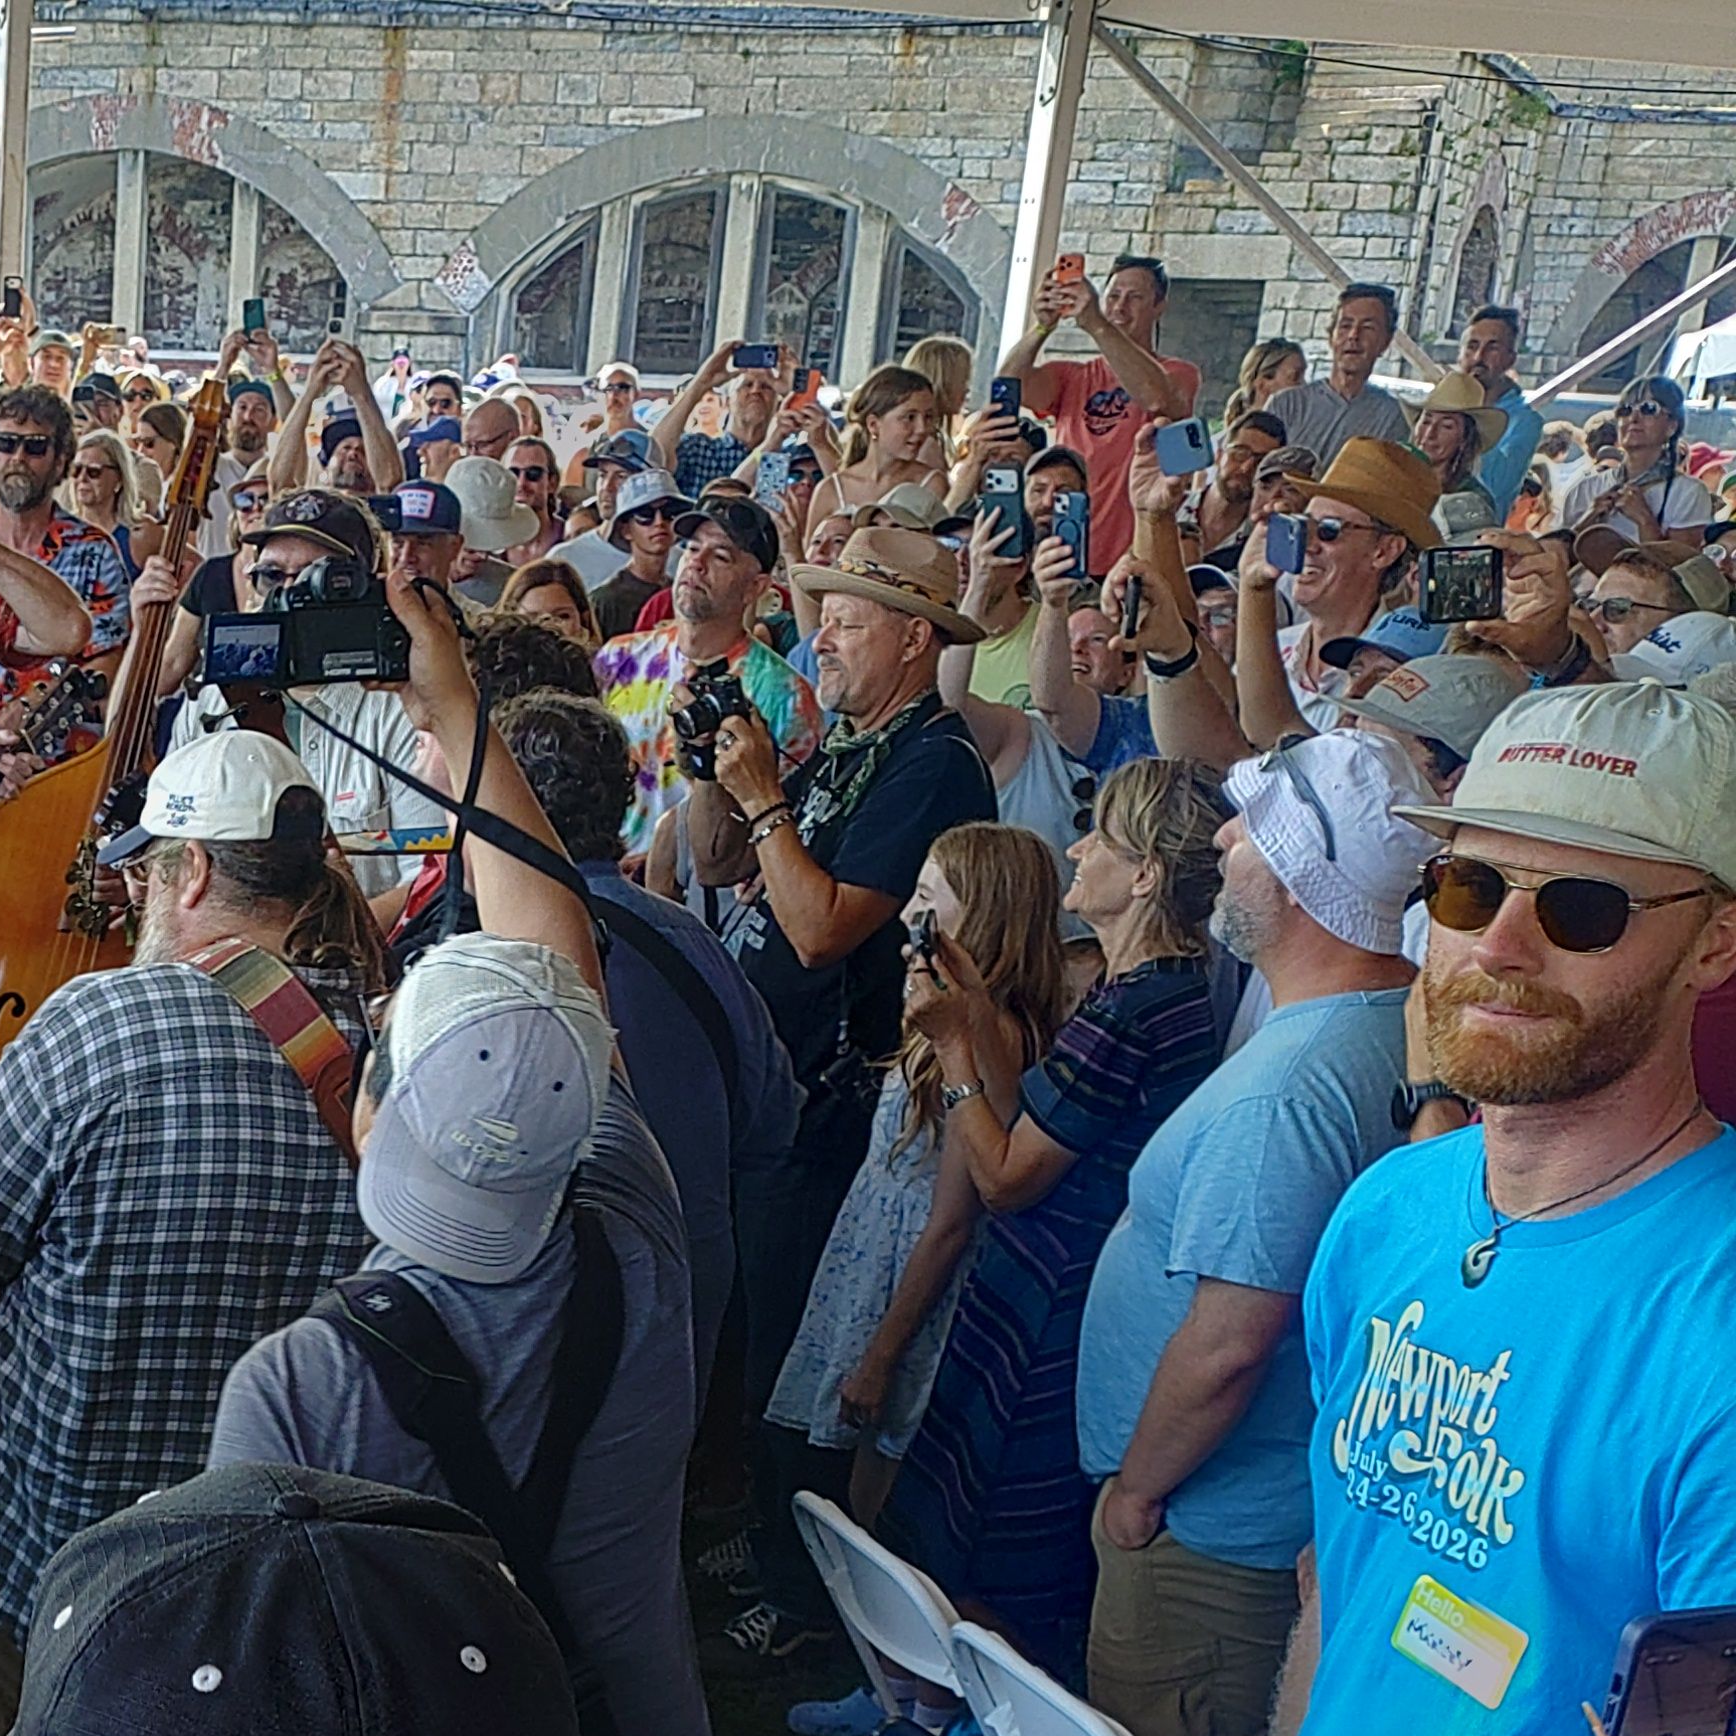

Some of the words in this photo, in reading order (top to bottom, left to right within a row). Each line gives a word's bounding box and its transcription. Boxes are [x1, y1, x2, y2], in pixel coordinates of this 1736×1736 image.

[1568, 748, 1638, 778] LOVER
[1334, 1300, 1513, 1474] Newport
[1349, 1441, 1388, 1482] July
[1388, 1426, 1524, 1545] Folk
[1414, 1509, 1489, 1570] 2026
[1415, 1583, 1464, 1628] Hello
